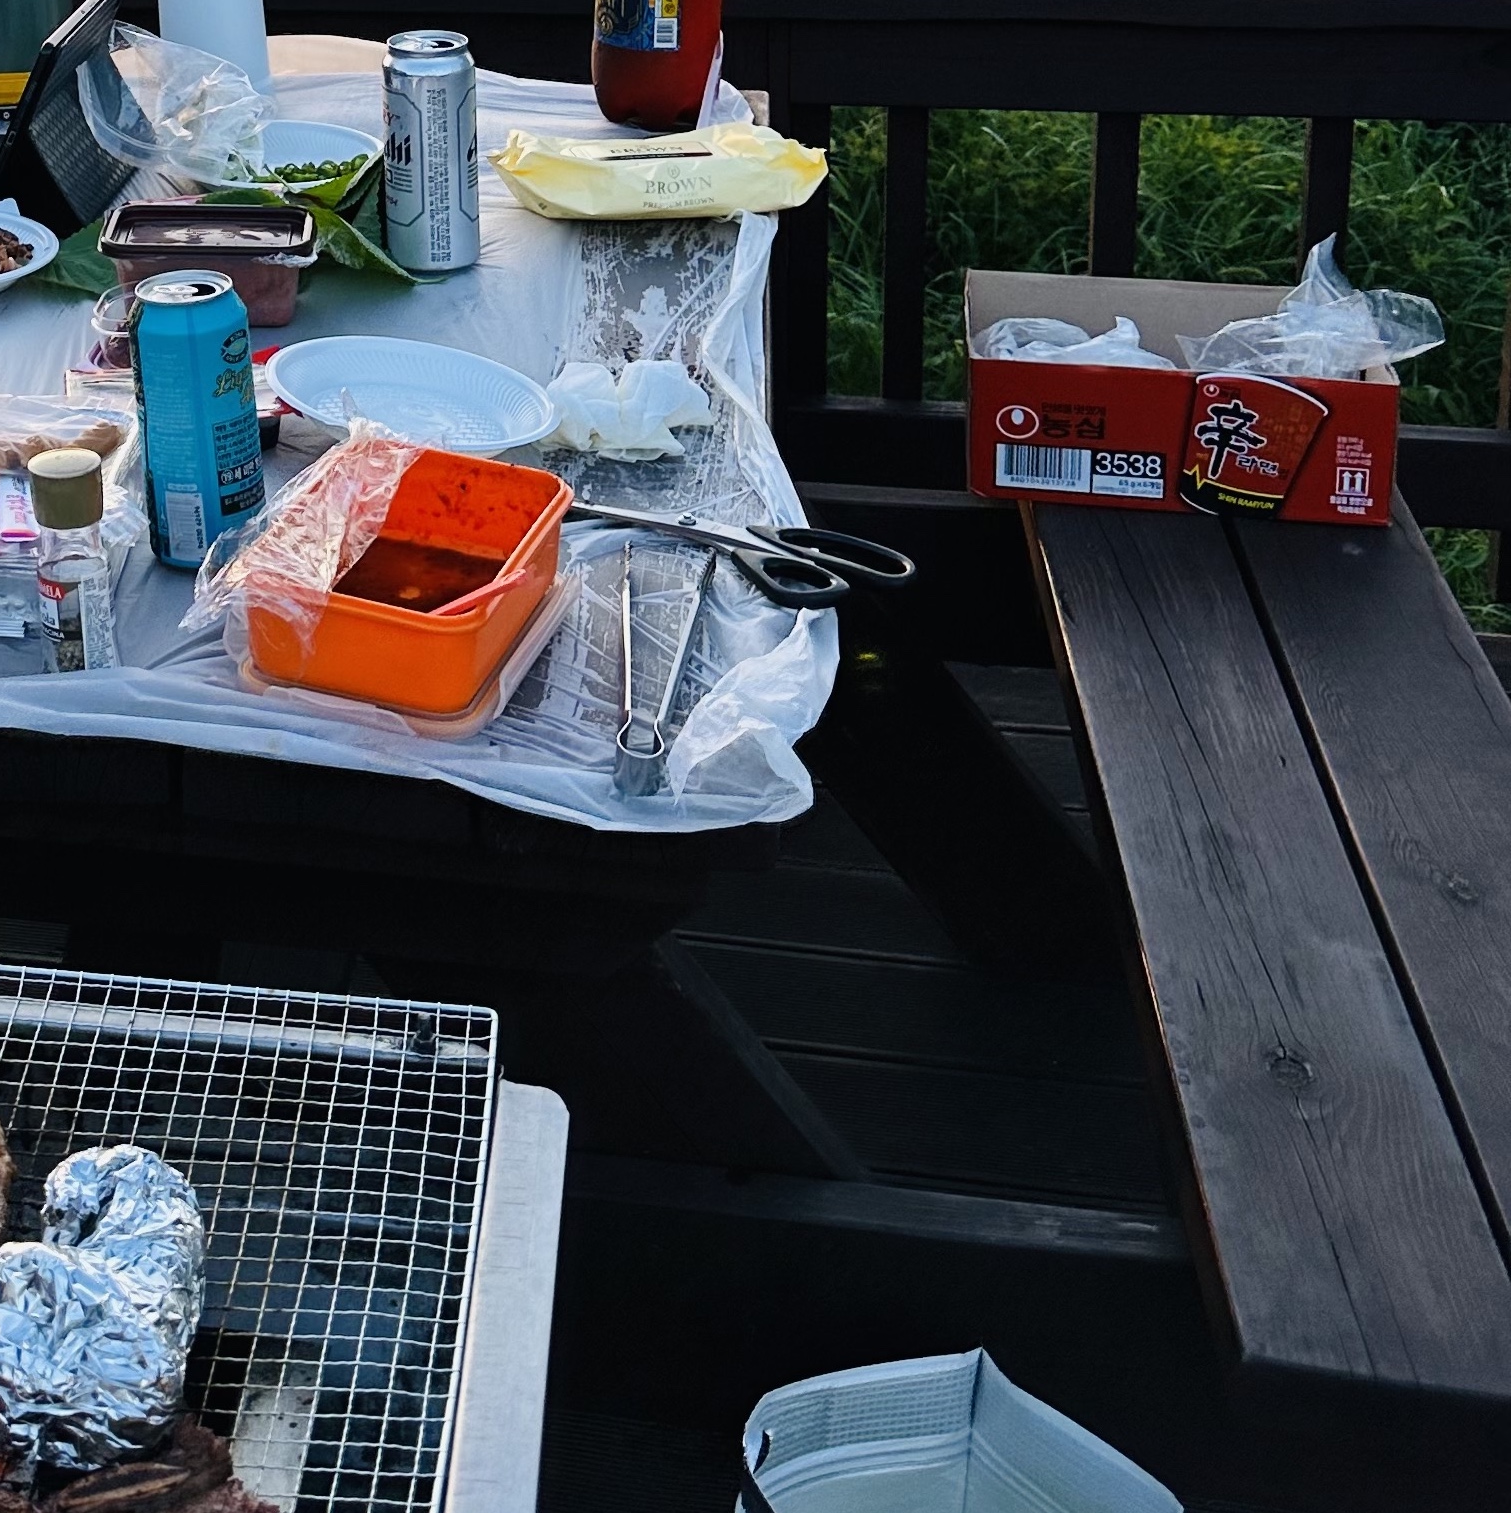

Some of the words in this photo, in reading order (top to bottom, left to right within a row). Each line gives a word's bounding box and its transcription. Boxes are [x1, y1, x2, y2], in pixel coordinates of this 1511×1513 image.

[644, 175, 712, 195] BROWN
[1043, 413, 1105, 439] 농심
[1095, 452, 1161, 477] 3538
[1237, 454, 1279, 477] 라면
